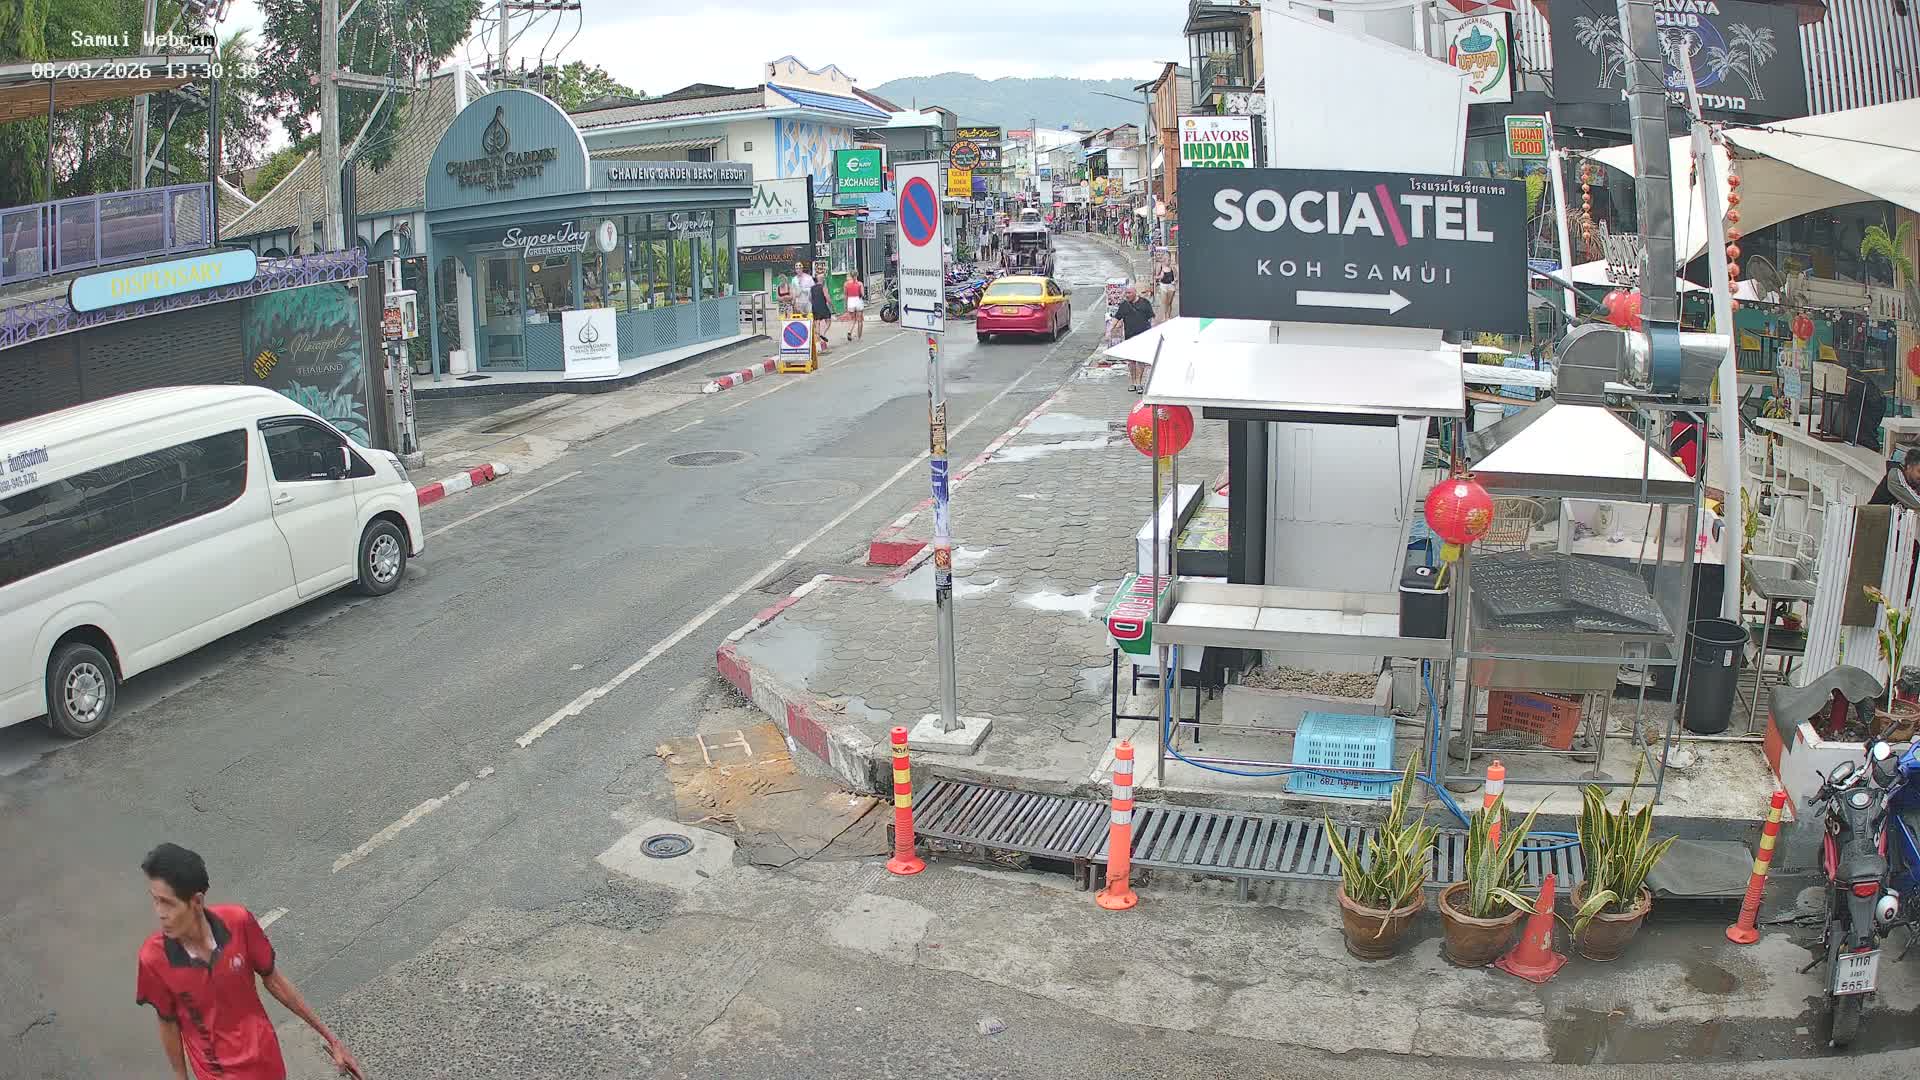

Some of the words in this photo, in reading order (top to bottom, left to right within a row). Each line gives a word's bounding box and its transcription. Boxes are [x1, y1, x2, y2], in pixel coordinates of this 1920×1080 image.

[1653, 0, 1720, 15] ALVATA
[1458, 18, 1479, 32] MEXICAN
[1479, 17, 1493, 28] FOOD
[1184, 130, 1249, 142] FLAVORS
[1511, 128, 1543, 139] INDIAN
[1183, 143, 1249, 160] INDIAN
[1513, 141, 1542, 153] FOOD
[504, 148, 557, 165] GARDEN
[611, 168, 656, 180] CHAWENG
[657, 168, 691, 180] GARDEN
[693, 168, 718, 180] BEACH
[720, 168, 747, 180] RESORT
[839, 178, 879, 187] EXCHANGE
[740, 208, 798, 217] CHAWENG
[528, 246, 551, 255] GREEN
[1257, 259, 1322, 278] KOH
[1344, 262, 1451, 284] SAMUI
[111, 261, 223, 298] DISPENSARY
[905, 287, 913, 296] NO
[914, 288, 937, 298] PARKING
[297, 363, 344, 376] THAILAND
